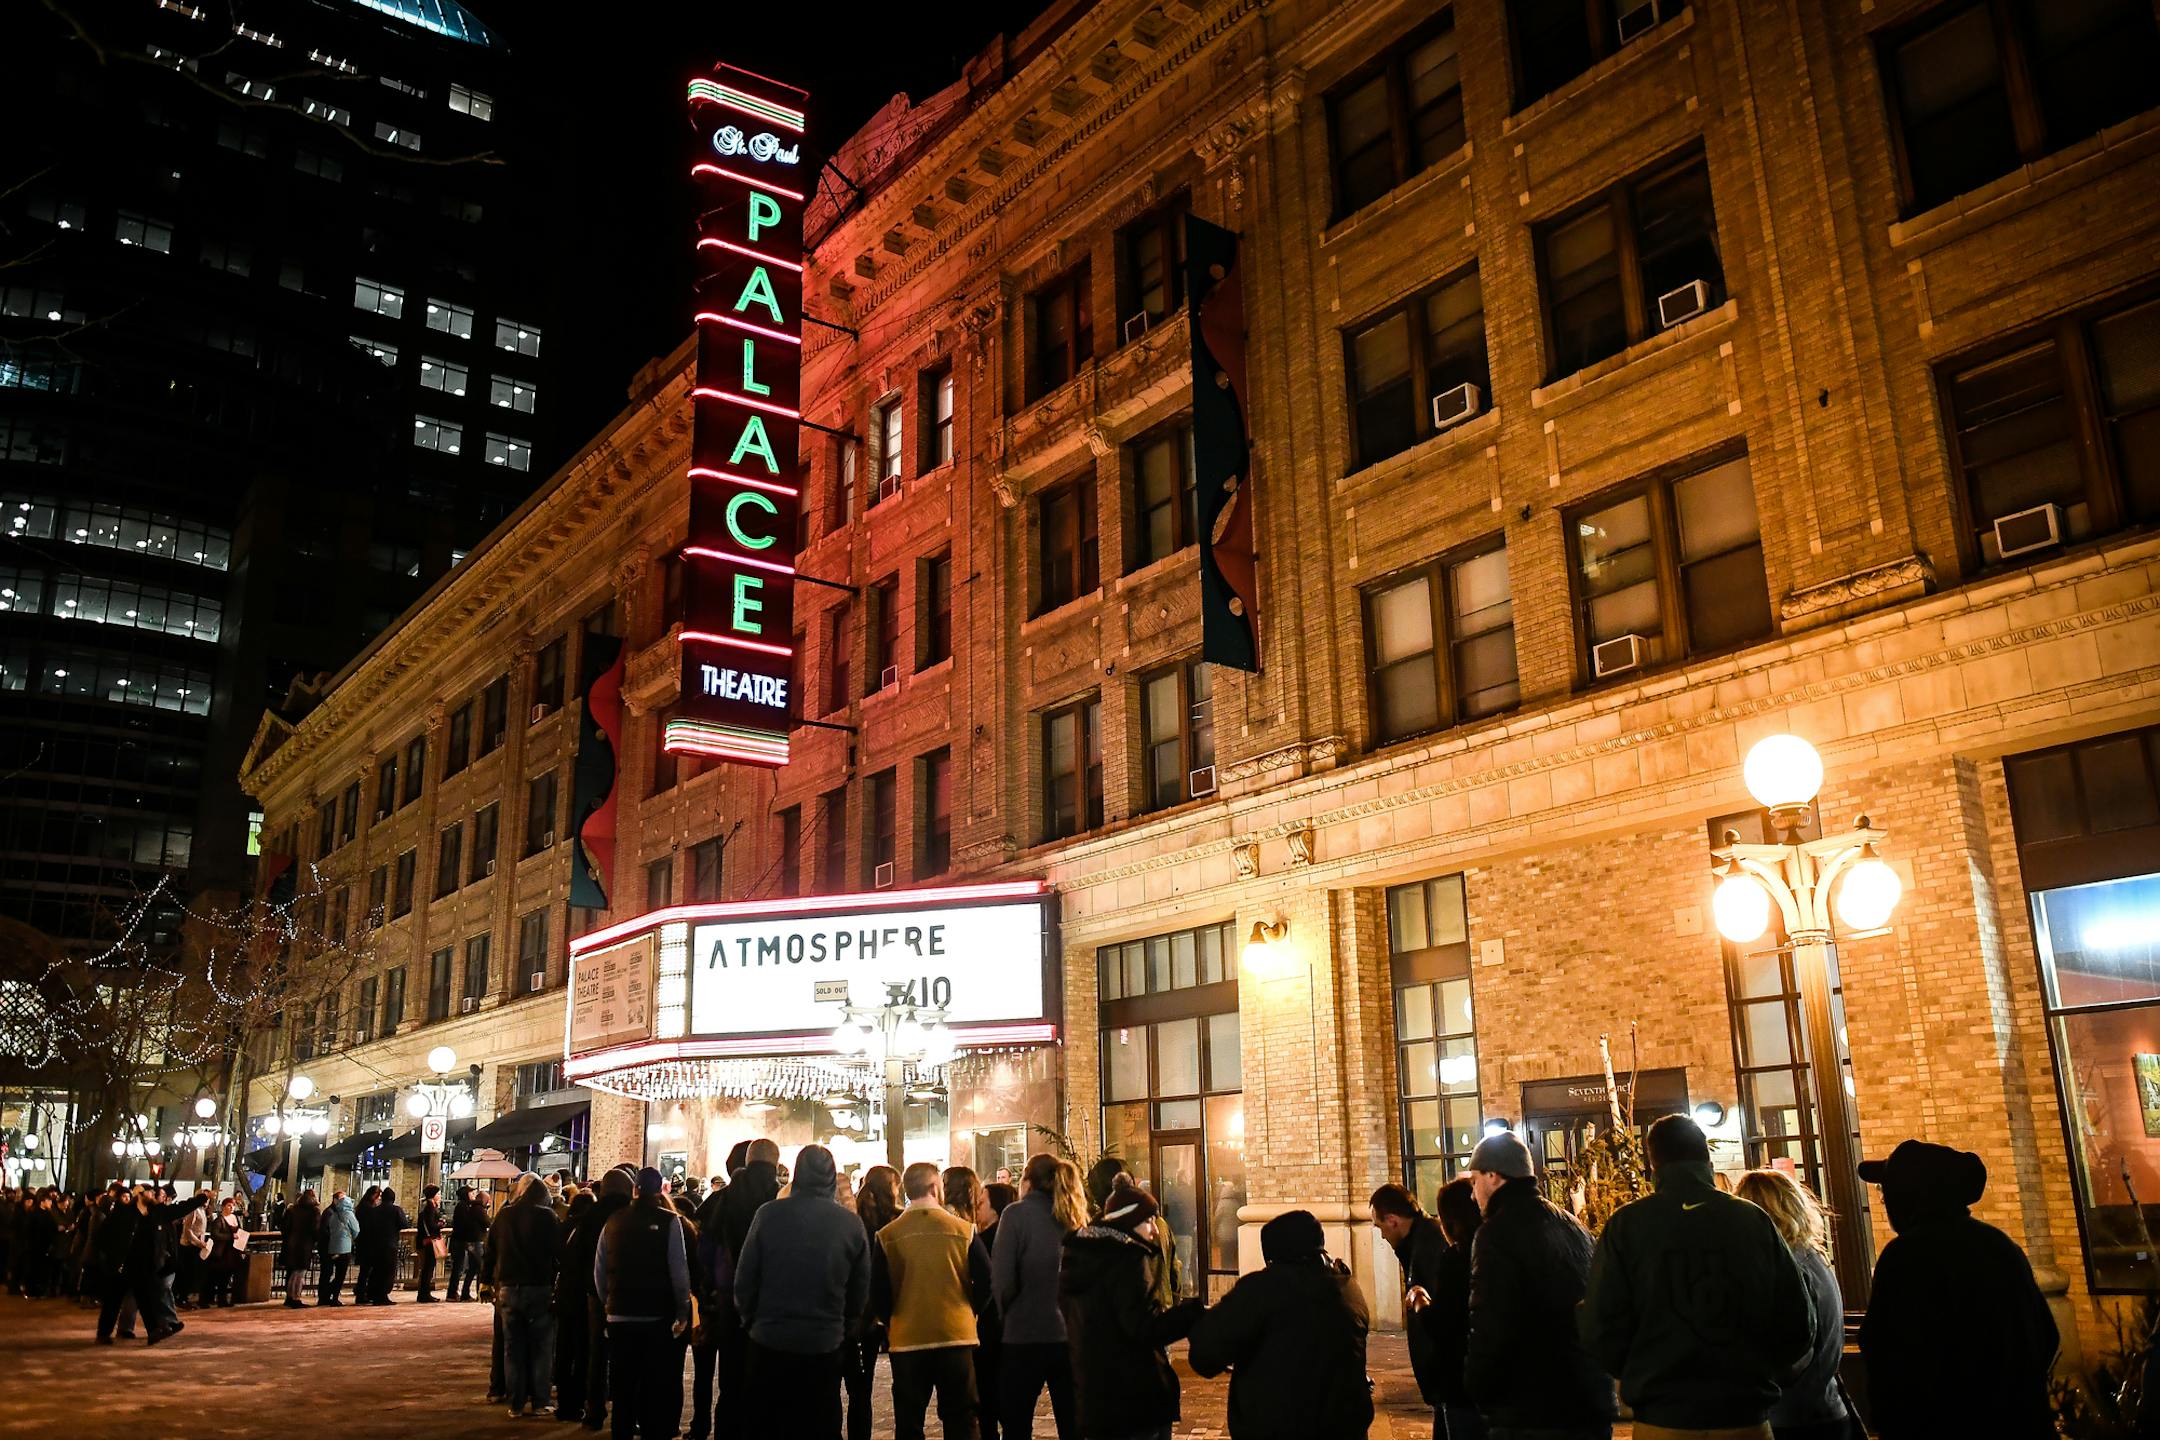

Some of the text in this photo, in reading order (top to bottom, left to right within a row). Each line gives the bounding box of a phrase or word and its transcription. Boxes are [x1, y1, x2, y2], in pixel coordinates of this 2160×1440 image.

[749, 132, 801, 165] Paul
[726, 190, 785, 635] PALACE
[700, 664, 788, 708] THEATRE
[709, 924, 946, 969] ATMOSPHERE
[578, 967, 599, 984] PALACE
[577, 983, 599, 1000] THEATRE
[834, 986, 847, 994] OUT
[1568, 1087, 1606, 1097] SEVENTH
